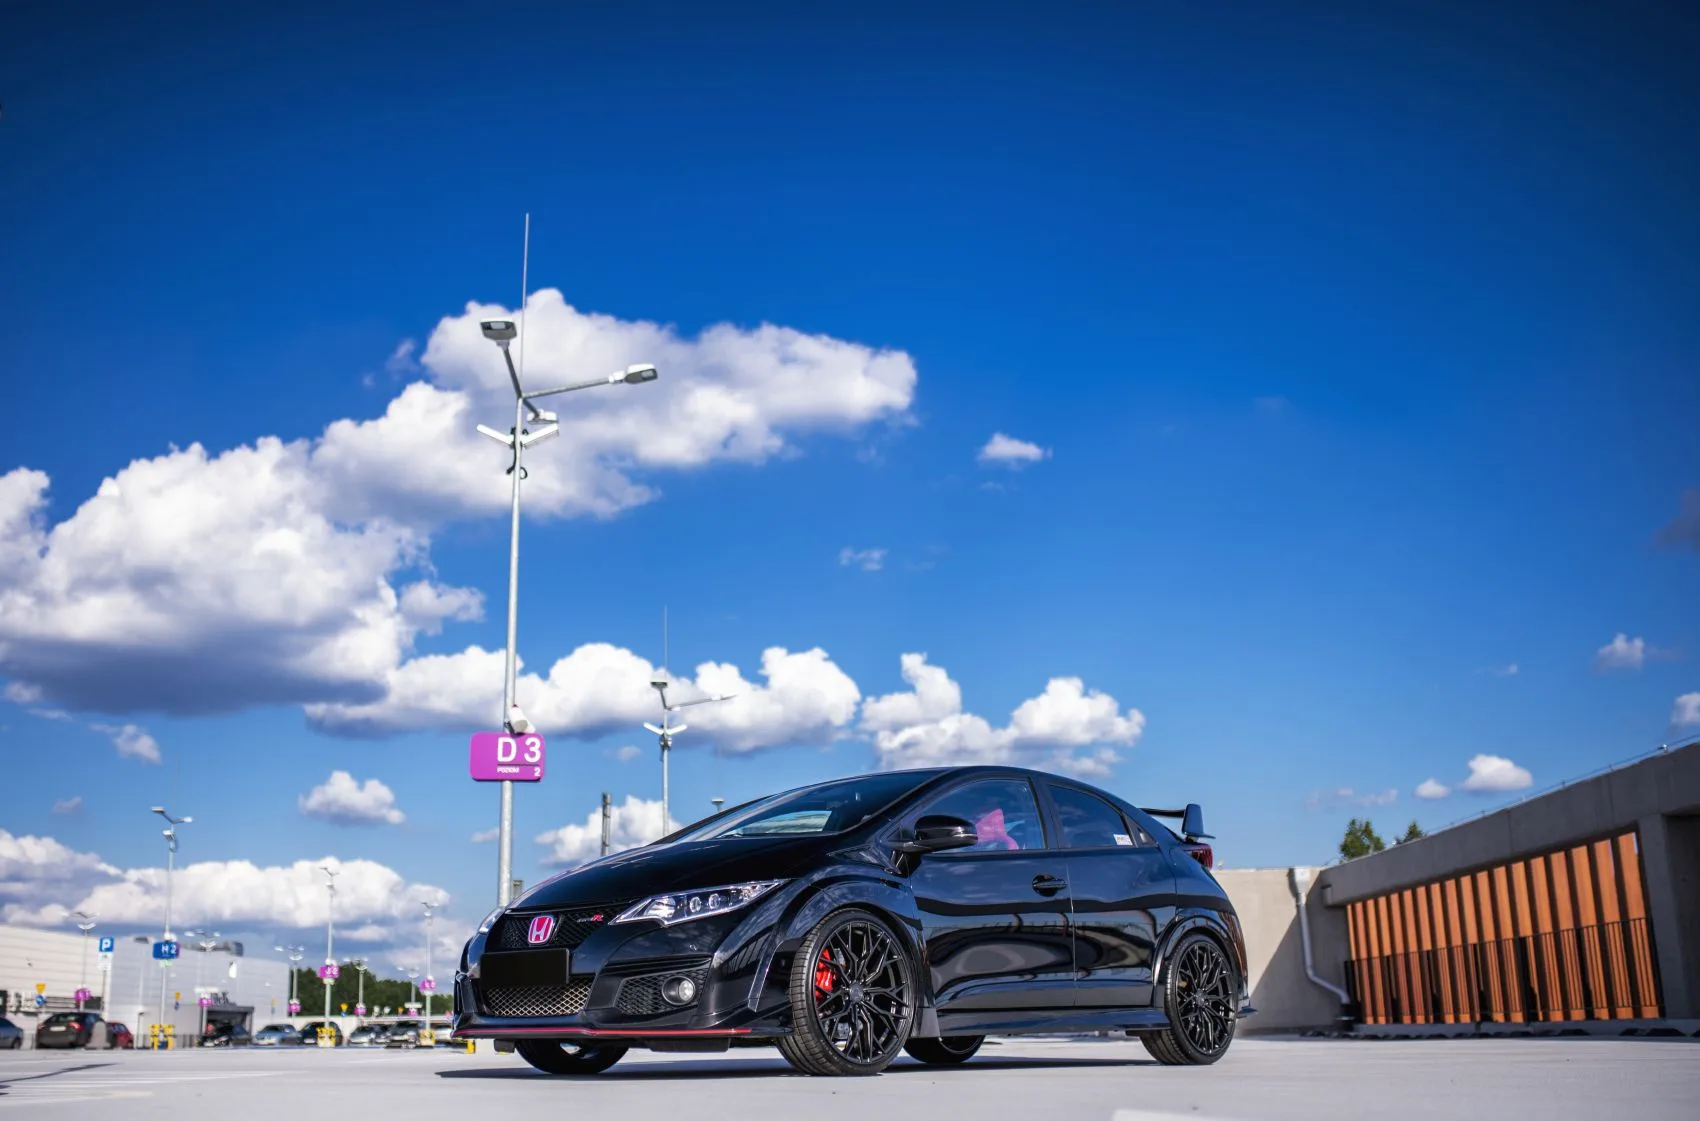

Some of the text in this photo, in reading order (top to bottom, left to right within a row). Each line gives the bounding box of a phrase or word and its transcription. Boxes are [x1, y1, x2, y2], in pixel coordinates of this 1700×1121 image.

[497, 737, 541, 763] D 3
[533, 767, 541, 777] 2
[101, 938, 111, 951] P
